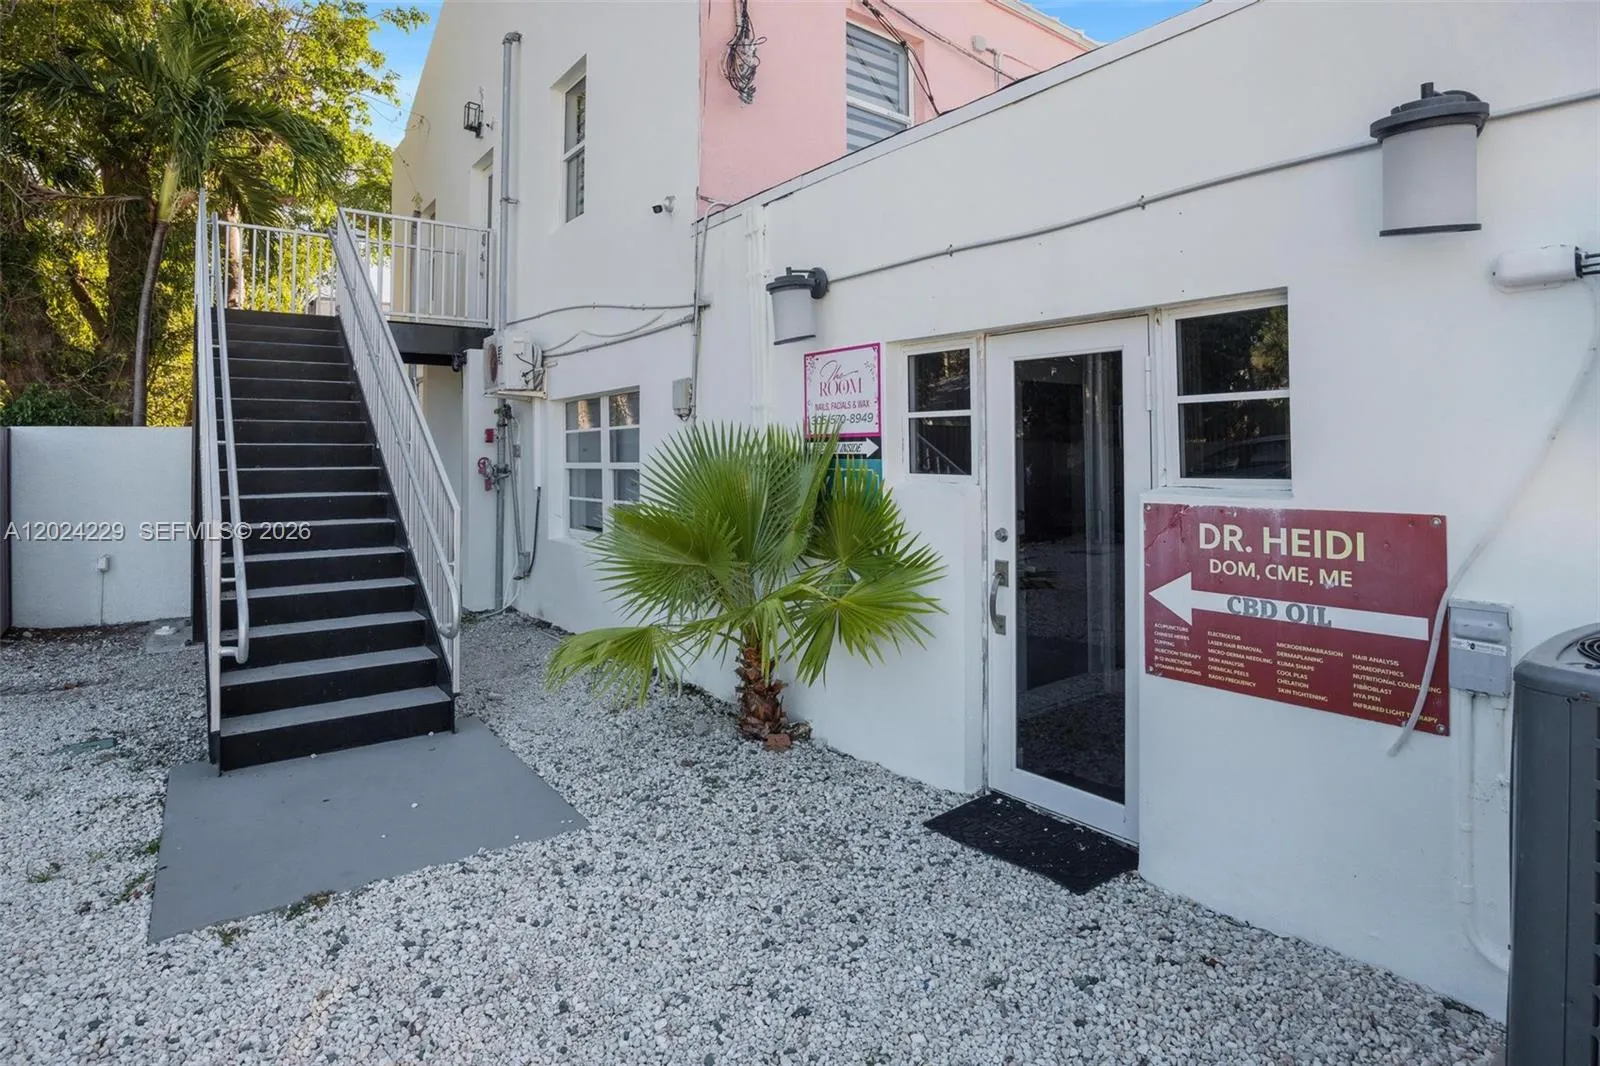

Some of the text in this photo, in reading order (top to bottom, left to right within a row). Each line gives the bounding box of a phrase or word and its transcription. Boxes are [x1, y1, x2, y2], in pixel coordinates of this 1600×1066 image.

[820, 360, 859, 382] The
[820, 377, 862, 396] ROOM
[831, 400, 851, 410] FACIALS
[858, 400, 870, 408] WAX
[840, 443, 862, 452] INSIDE
[1199, 522, 1365, 562] DR. HEIDI
[1209, 558, 1353, 588] DOM, CME, ME
[1226, 596, 1332, 628] CBD OIL
[1154, 623, 1189, 632] ACUPUNCTURE
[1154, 630, 1173, 639] CHINESE
[1207, 630, 1241, 641] ELECTROLYSIS
[1154, 639, 1175, 647] CUPPING
[1224, 641, 1236, 649] HAIR
[1237, 644, 1263, 654] REMOVAL
[1179, 651, 1201, 660] THERAPY
[1276, 642, 1344, 658] MICRODERMABRASION
[1245, 654, 1273, 664] NEEDLING
[1276, 650, 1324, 664] DERMAPLANING
[1352, 654, 1400, 667] HAIR ANALYSIS
[1221, 659, 1245, 668] ANALYSIS
[1276, 660, 1315, 672] KUMA SHAPE
[1175, 667, 1202, 676] INFUSIONS
[1207, 664, 1249, 678] CHEMICAL PEELS
[1276, 669, 1308, 680] COOL PLAS
[1352, 664, 1404, 678] HOMEOPATHICS
[1208, 673, 1257, 687] RADIO FREQUENCY
[1276, 678, 1309, 689] CHELATION
[1353, 683, 1393, 695] FIBROBLAST
[1397, 680, 1442, 694] COUNSING
[1277, 687, 1328, 702] SKIN TIGHTENING
[1367, 694, 1381, 702] PEN
[1352, 702, 1438, 724] INFRARED LIGHT TRAPY
